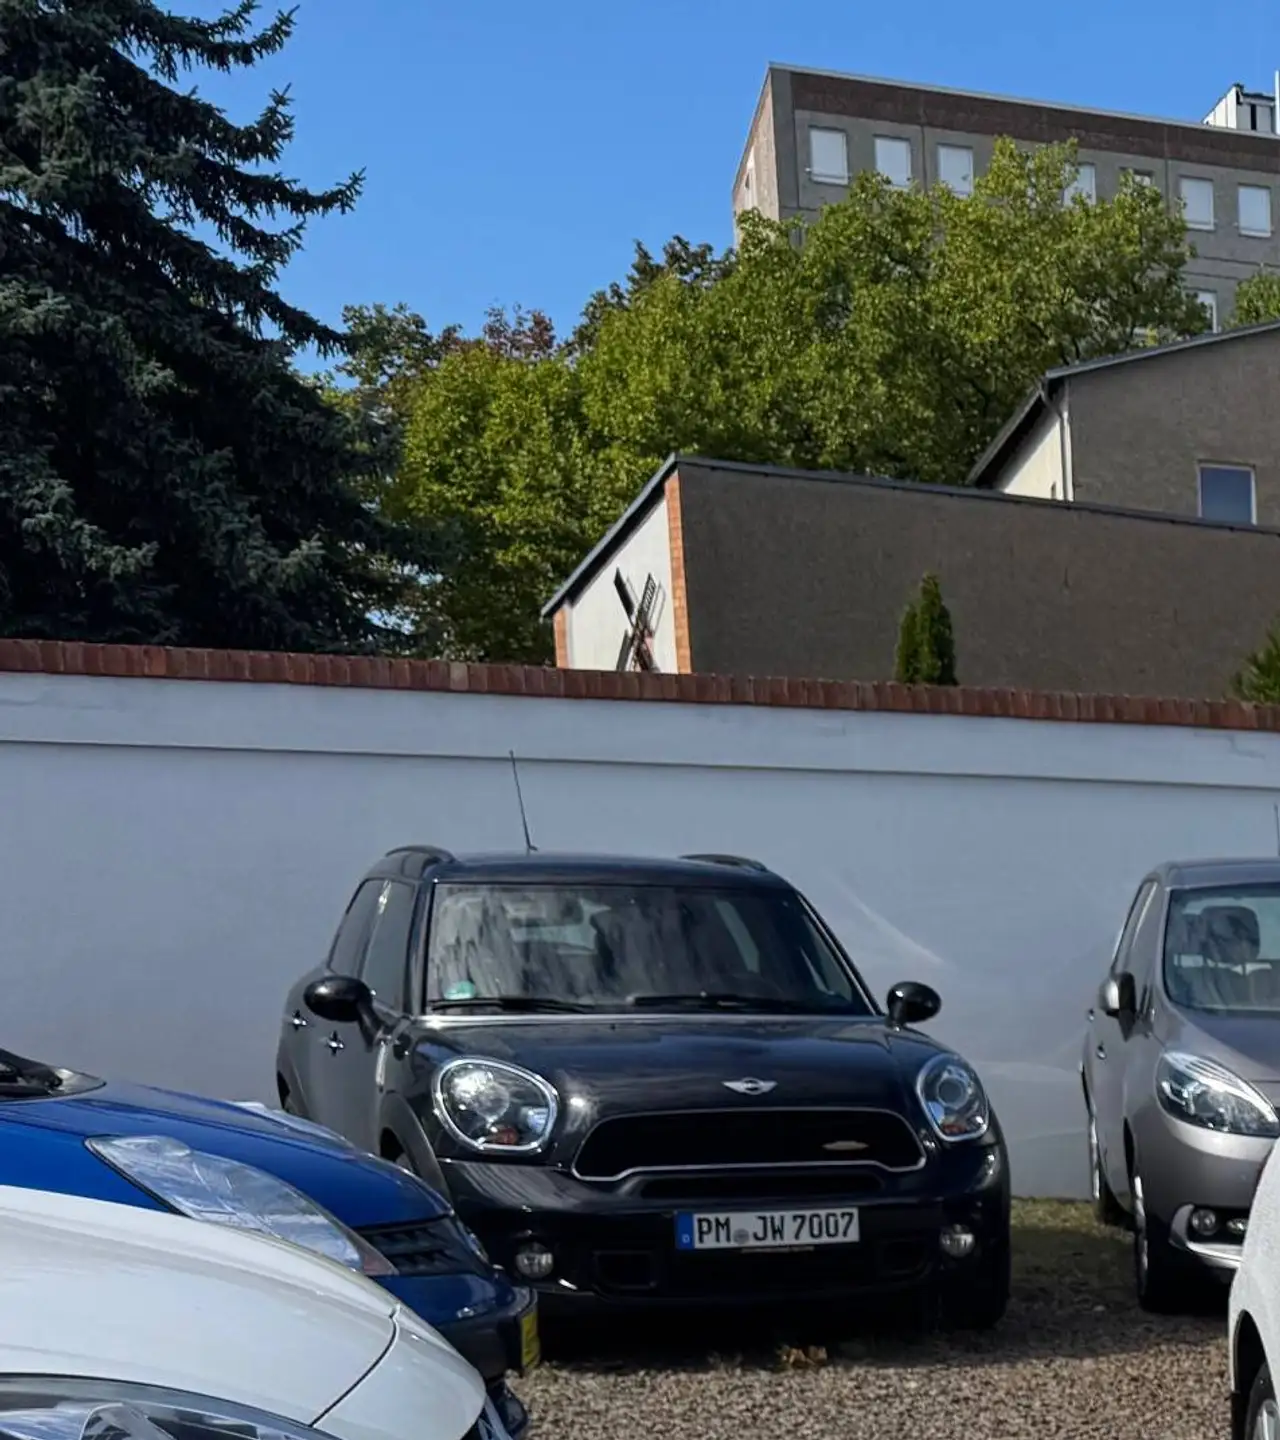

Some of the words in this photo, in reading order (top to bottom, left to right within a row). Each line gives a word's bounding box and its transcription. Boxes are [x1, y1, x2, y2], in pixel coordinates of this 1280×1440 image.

[697, 1216, 731, 1243] PM
[753, 1215, 785, 1241] JW
[792, 1212, 854, 1240] 7007
